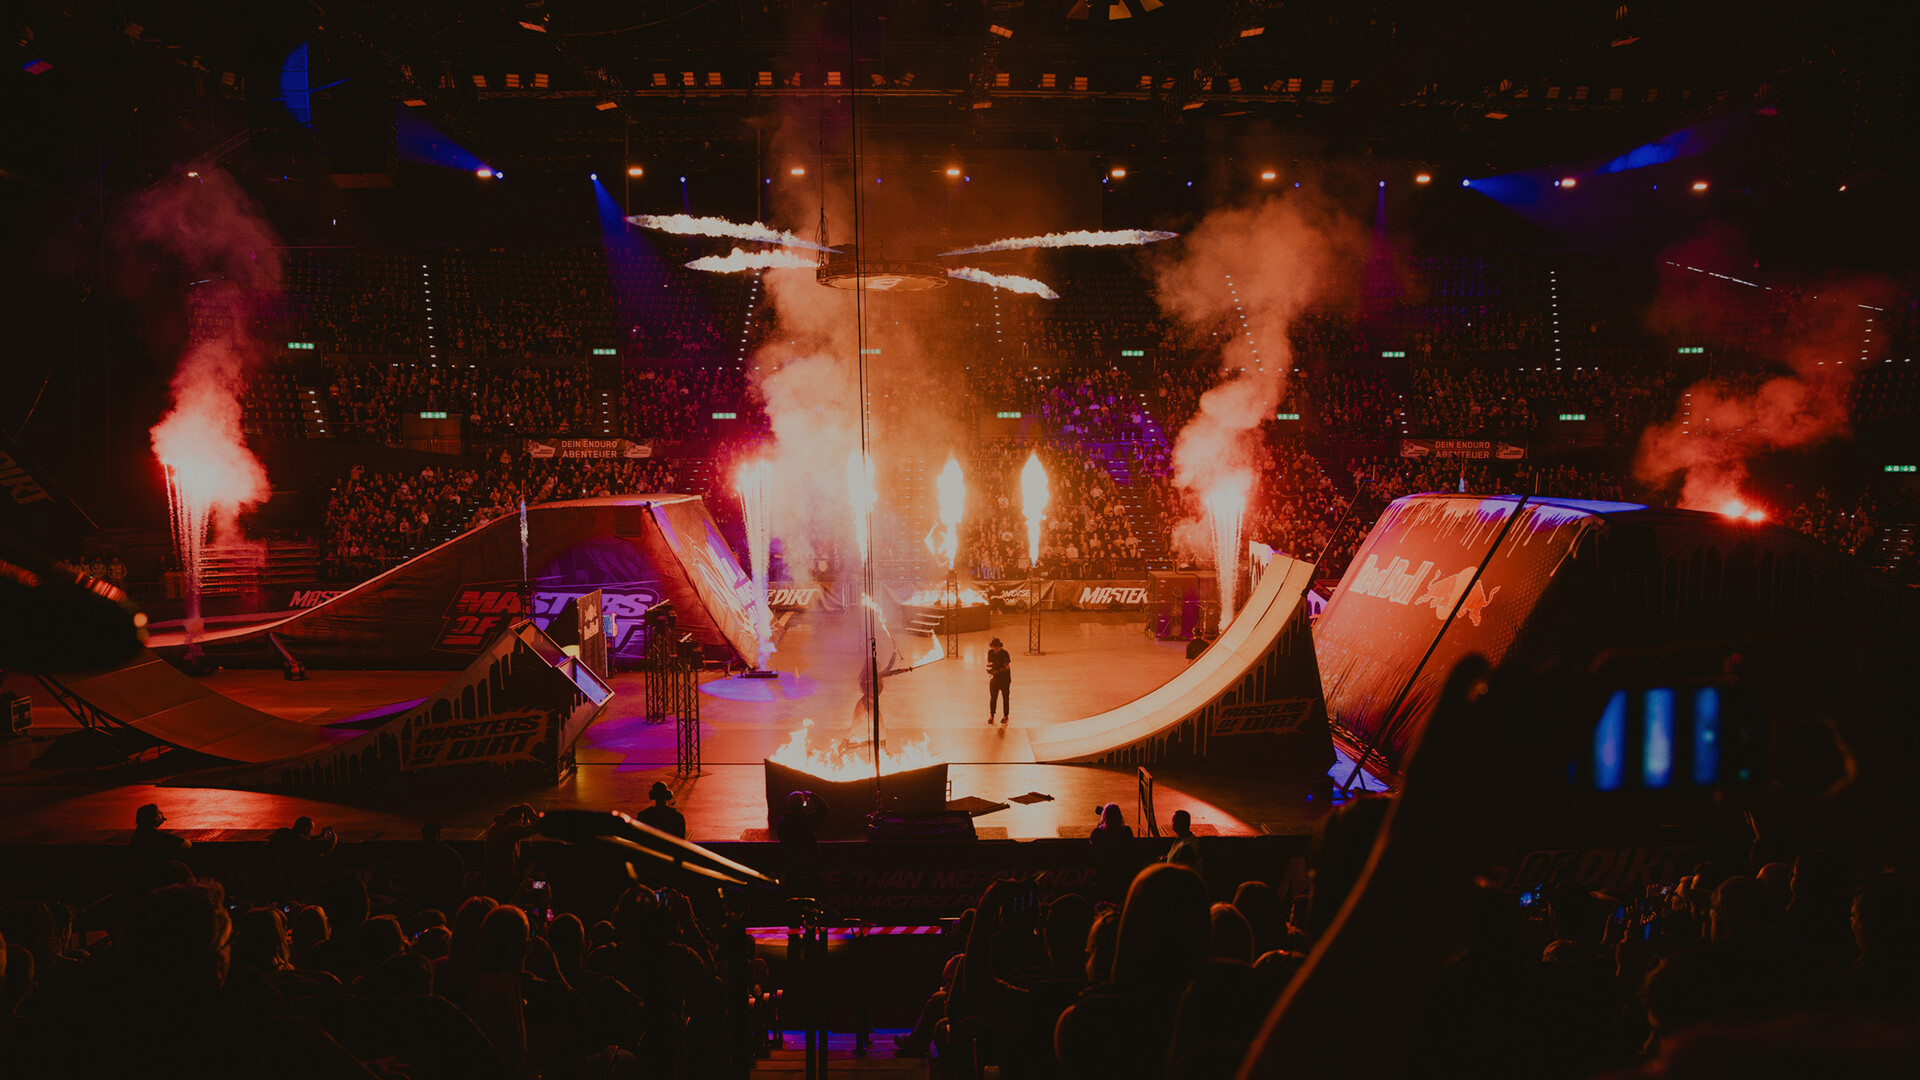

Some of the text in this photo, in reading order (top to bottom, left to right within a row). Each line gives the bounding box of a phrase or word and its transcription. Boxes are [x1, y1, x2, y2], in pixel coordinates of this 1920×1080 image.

[561, 440, 618, 448] DEIN ENDURO
[1435, 441, 1490, 449] DEIN ENDURO
[561, 450, 617, 459] ABENTEUER
[1435, 450, 1490, 459] ABENTEUER
[777, 588, 820, 606] DIRT
[414, 715, 541, 744] MASTERS
[447, 732, 534, 762] DIRT
[1575, 847, 1696, 892] DIRT
[852, 869, 924, 889] THAN
